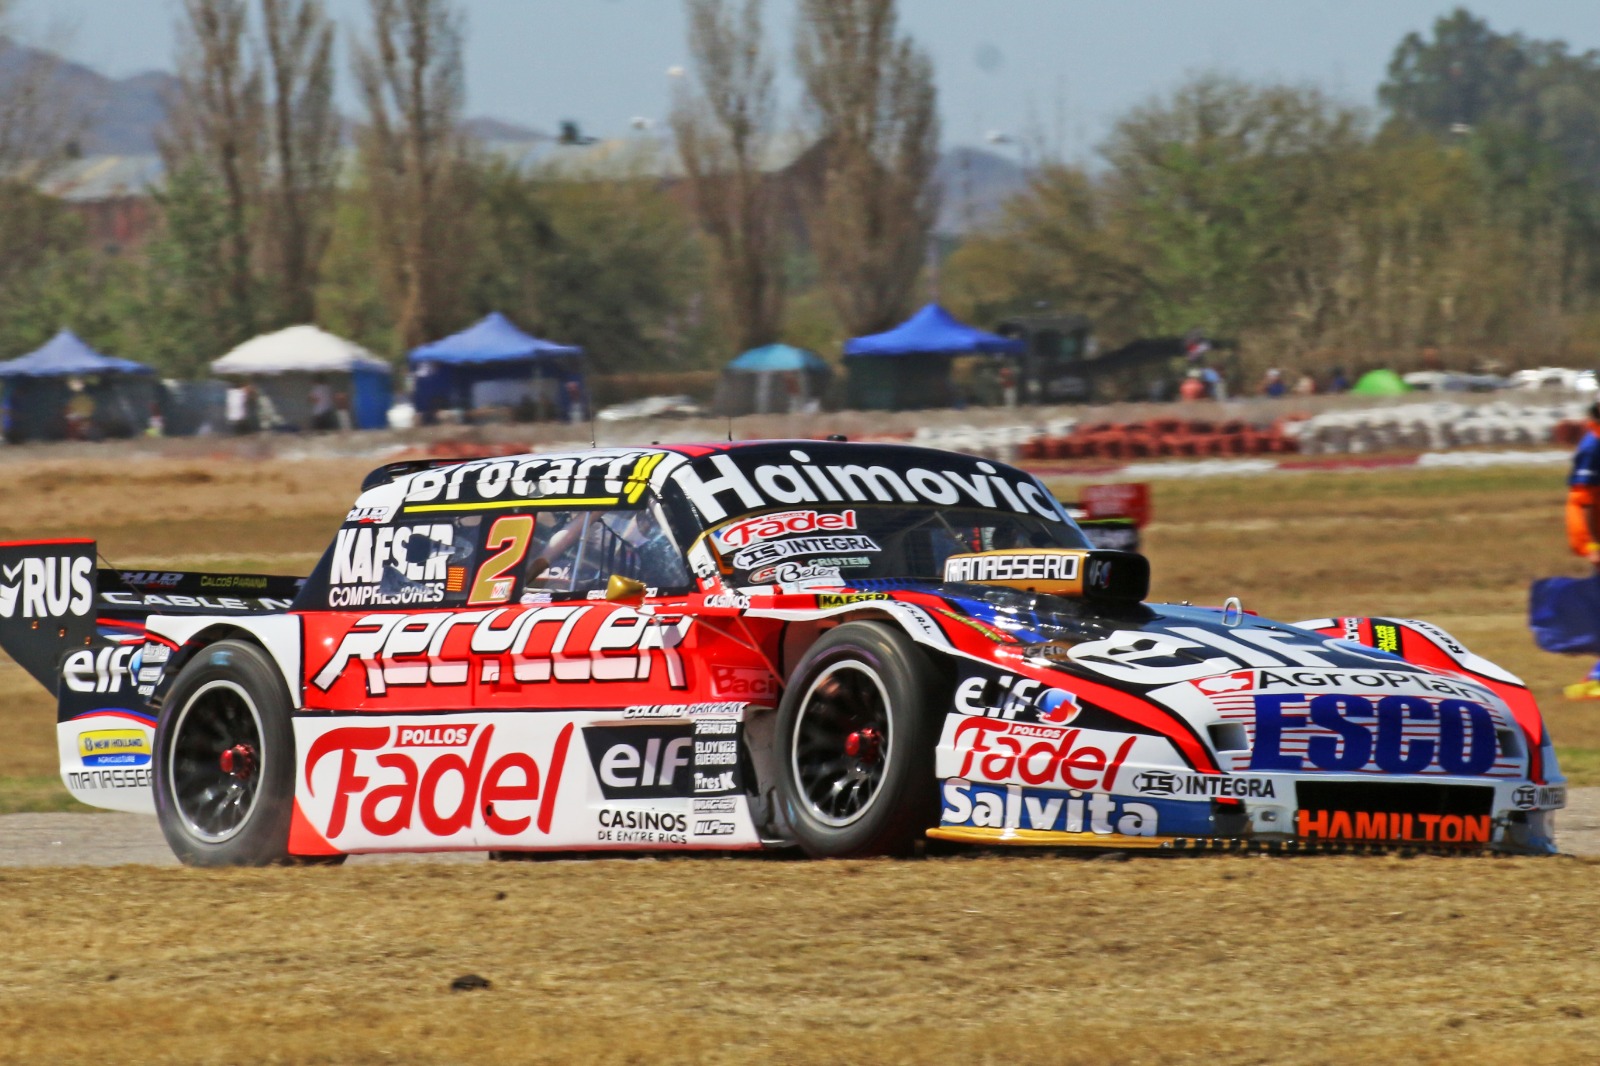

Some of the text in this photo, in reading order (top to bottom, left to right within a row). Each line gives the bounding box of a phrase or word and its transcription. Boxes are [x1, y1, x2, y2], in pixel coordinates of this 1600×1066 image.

[723, 511, 854, 546] Fadel
[787, 535, 875, 554] INTEGRA
[468, 514, 536, 606] 2
[945, 554, 1078, 582] MANASSERO
[703, 595, 751, 609] CASINOS
[822, 594, 888, 606] KAESER
[63, 646, 134, 693] elf
[1066, 626, 1337, 685] elf
[402, 728, 468, 746] POLLOS
[1012, 724, 1062, 739] POLLOS
[1251, 693, 1498, 775] ESCO
[600, 737, 692, 788] elf
[954, 717, 1137, 792] Fadel
[305, 722, 574, 838] Fadel
[1186, 776, 1275, 798] INTEGRA
[599, 809, 687, 832] CASINOS
[940, 777, 1159, 837] Salvita
[598, 832, 688, 844] DE ENTRE RIOS
[1296, 810, 1491, 843] HAMILTON
